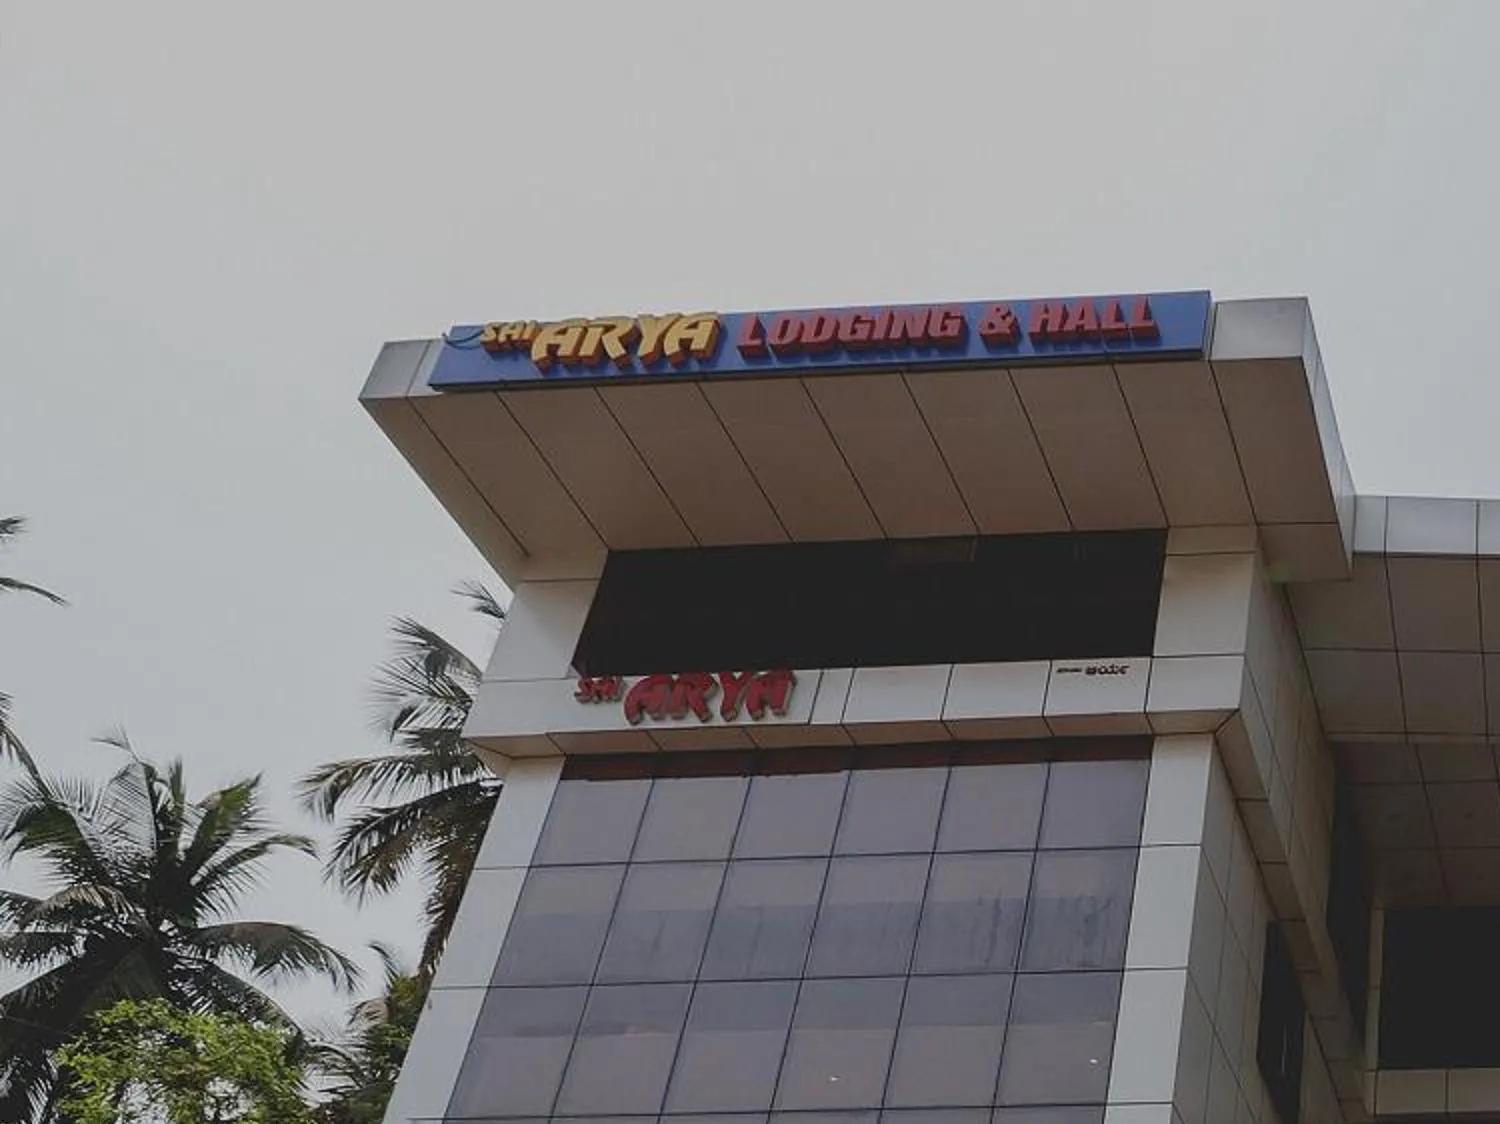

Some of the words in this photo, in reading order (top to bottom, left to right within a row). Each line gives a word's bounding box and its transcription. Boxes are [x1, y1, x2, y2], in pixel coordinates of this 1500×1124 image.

[480, 320, 537, 352] SAI
[530, 312, 722, 368] ARYA
[737, 304, 968, 358] LODGING
[978, 302, 1018, 348] &
[1028, 295, 1160, 344] HALL
[623, 667, 796, 725] ARYA
